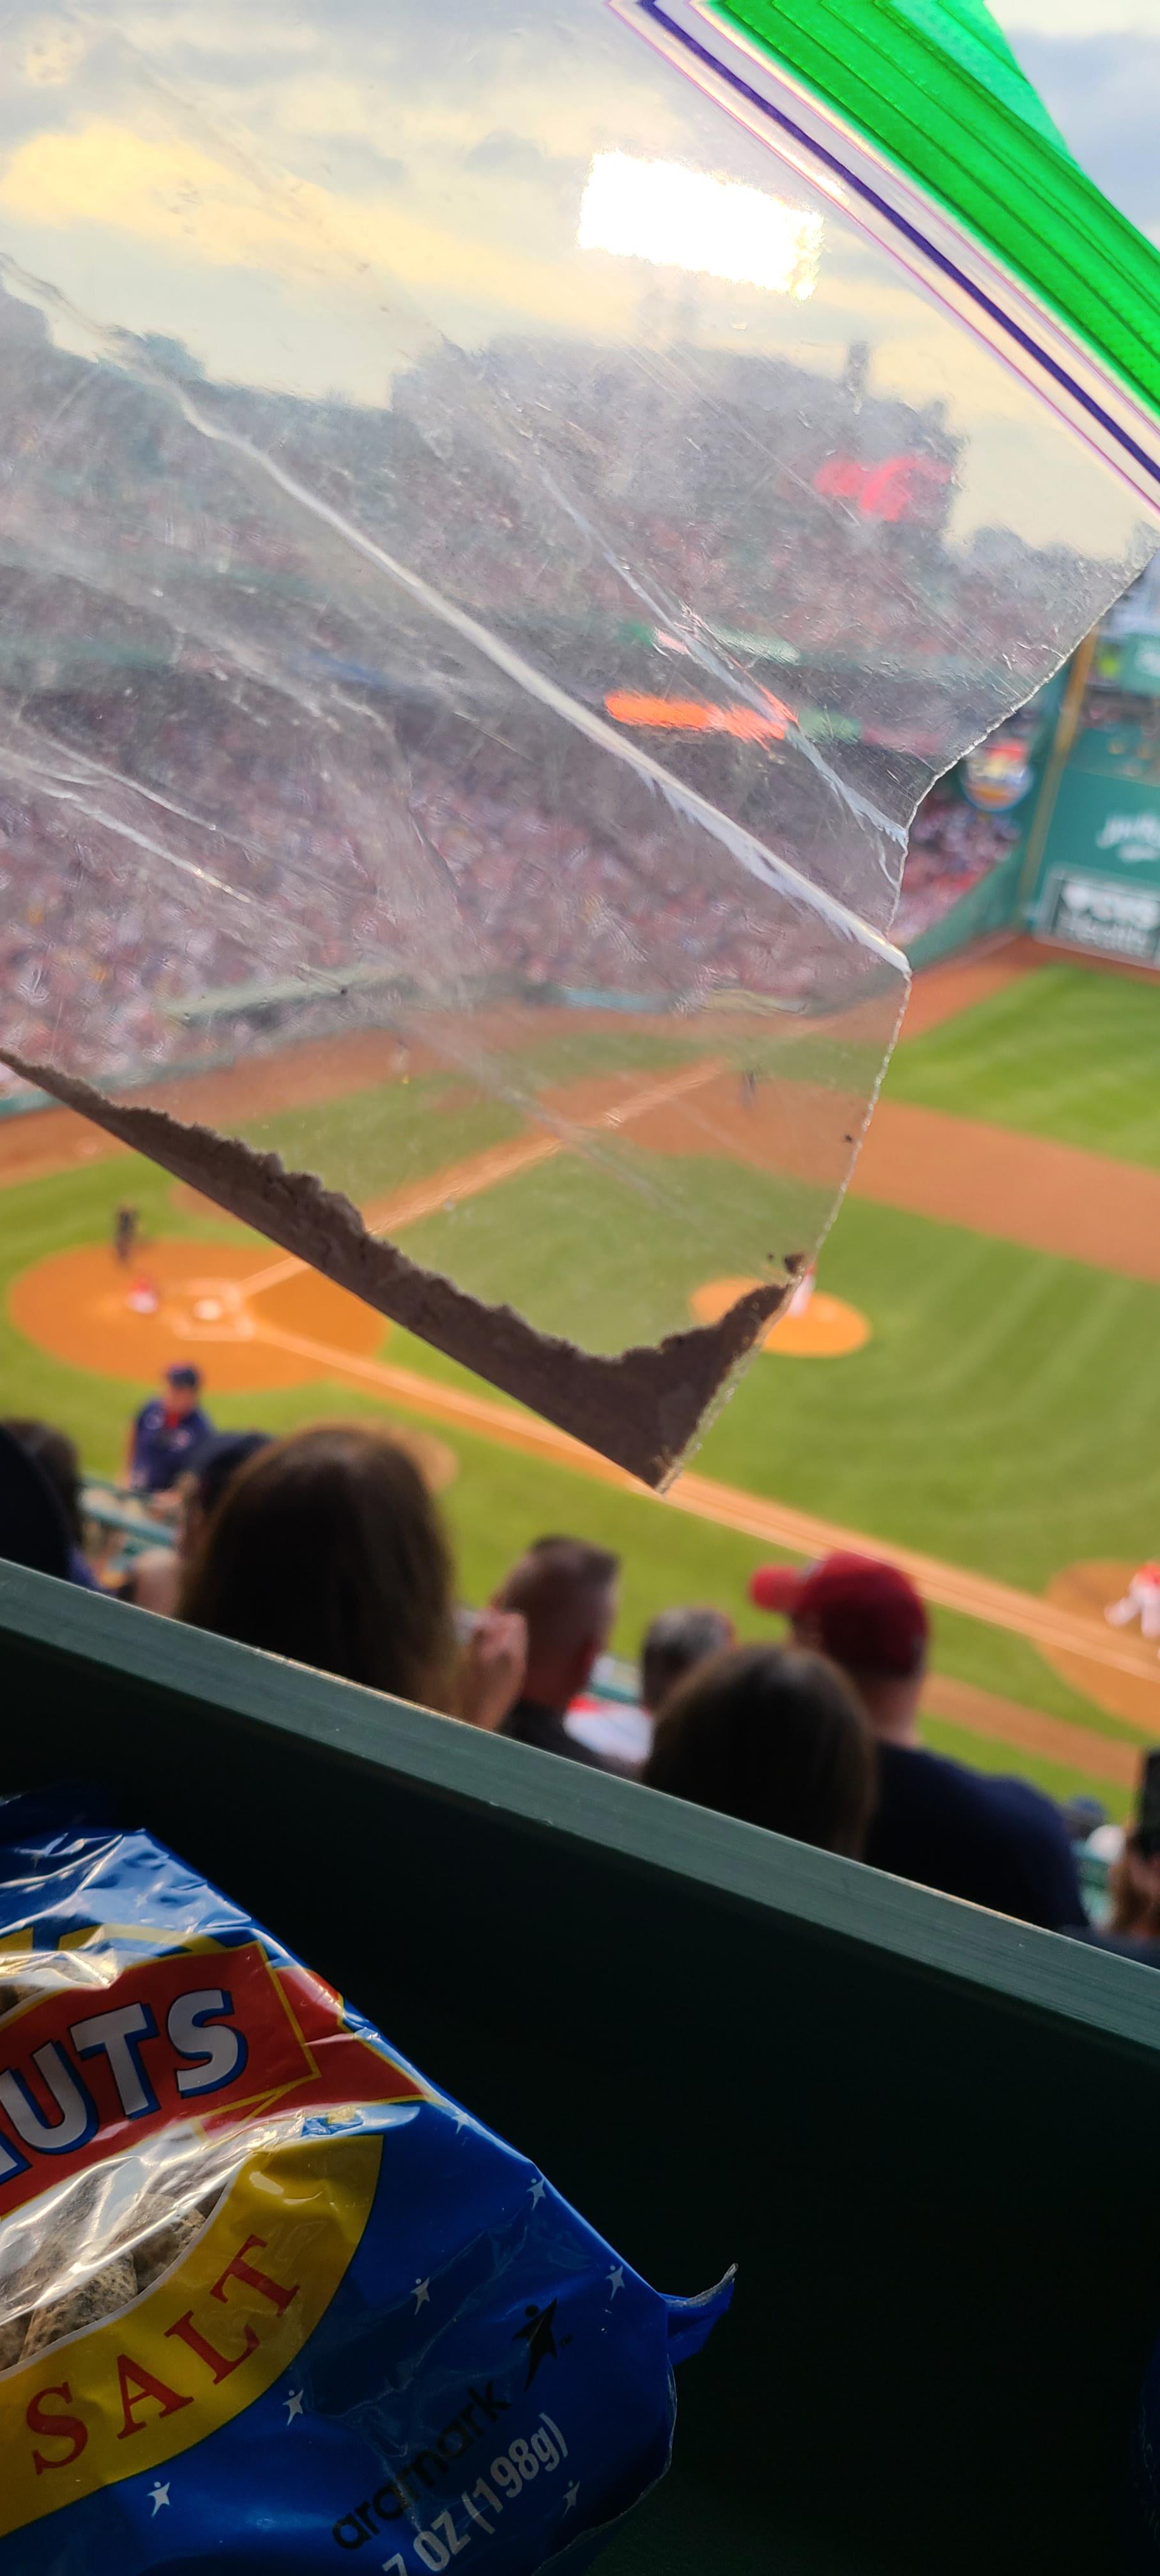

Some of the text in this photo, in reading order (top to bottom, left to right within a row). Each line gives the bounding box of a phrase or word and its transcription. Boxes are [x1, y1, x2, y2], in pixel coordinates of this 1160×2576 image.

[0, 1988, 248, 2181] UTS
[26, 2234, 300, 2474] SALT
[333, 2382, 512, 2550] aramark
[461, 2413, 568, 2534] (198g)
